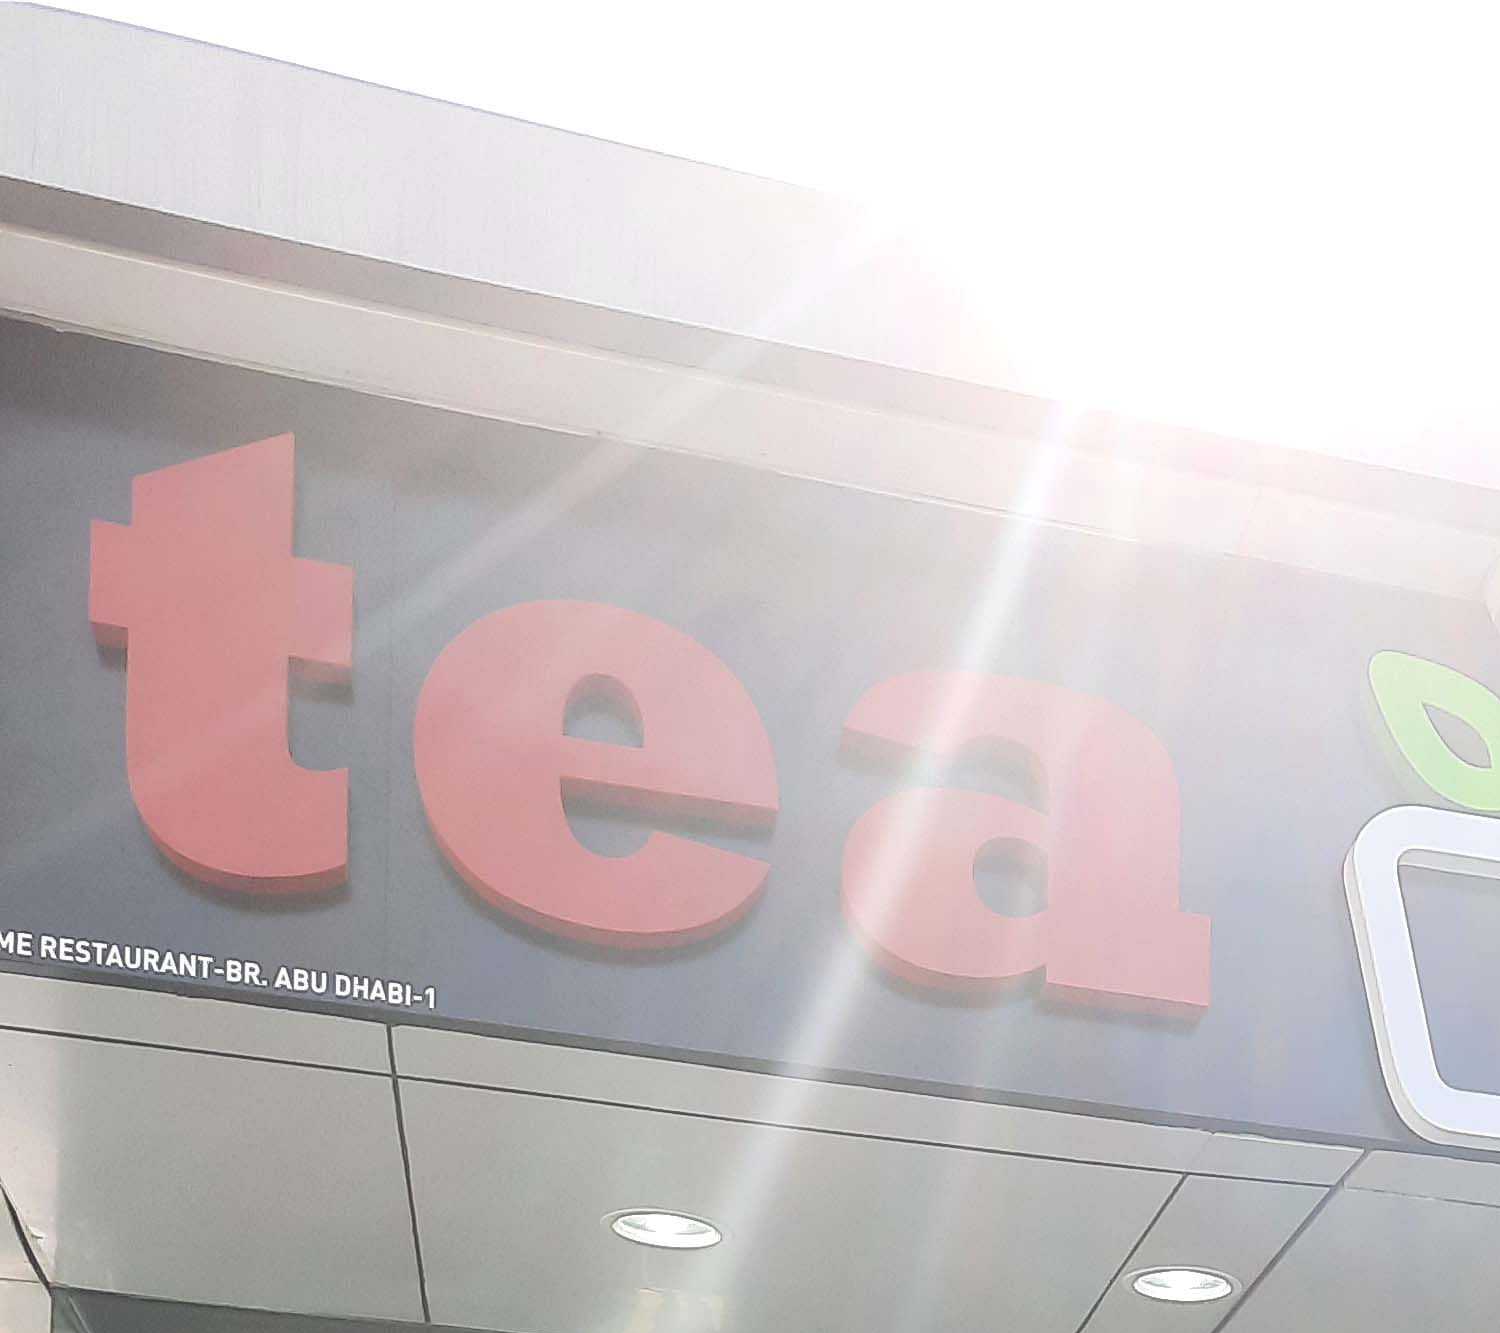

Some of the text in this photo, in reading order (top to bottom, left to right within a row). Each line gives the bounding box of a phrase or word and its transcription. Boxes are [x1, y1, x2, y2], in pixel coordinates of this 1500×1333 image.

[89, 432, 1212, 1022] tea
[40, 934, 268, 986] RESTAURANT-BR.
[273, 966, 328, 994] ABU
[334, 973, 436, 1009] DHABI-1
